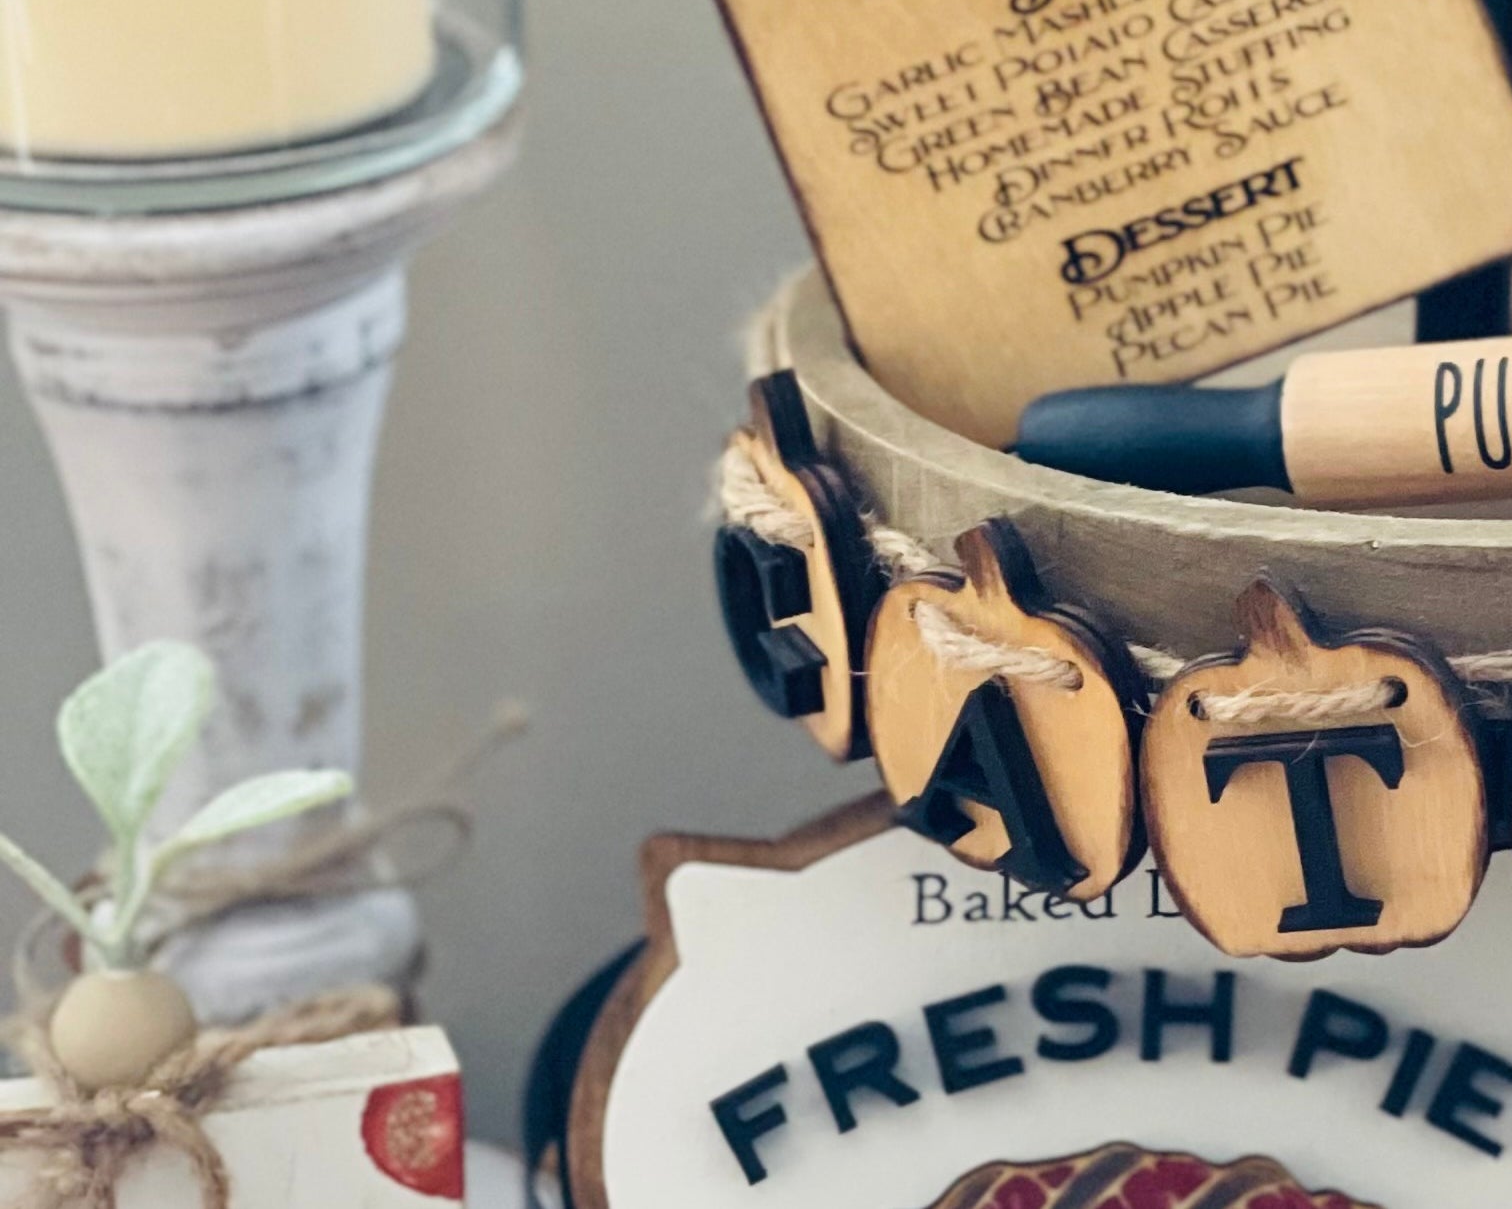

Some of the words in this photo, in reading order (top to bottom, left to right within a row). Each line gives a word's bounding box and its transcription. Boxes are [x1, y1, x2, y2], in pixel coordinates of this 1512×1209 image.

[826, 43, 985, 120] GARLIC
[848, 83, 978, 156] SWEET
[993, 13, 1155, 92] POTATO
[877, 108, 1015, 174] GREEN
[1035, 53, 1148, 117] BEAN
[926, 92, 1149, 192] HOMEMADE
[1170, 8, 1351, 104] STUFFING
[994, 126, 1149, 207] DINNER
[1162, 69, 1291, 138] ROLLS
[978, 147, 1191, 243] CRANBERRY
[1214, 82, 1348, 159] SAUCE
[1059, 156, 1304, 286] DESSERT
[1067, 234, 1247, 321] PUMPKIN
[1256, 201, 1329, 248] PIE
[1106, 276, 1235, 347] APPLE
[1247, 241, 1321, 288] PIE
[1110, 306, 1253, 378] PECAN
[1262, 272, 1336, 320] PIE
[710, 964, 1236, 1186] FRESH
